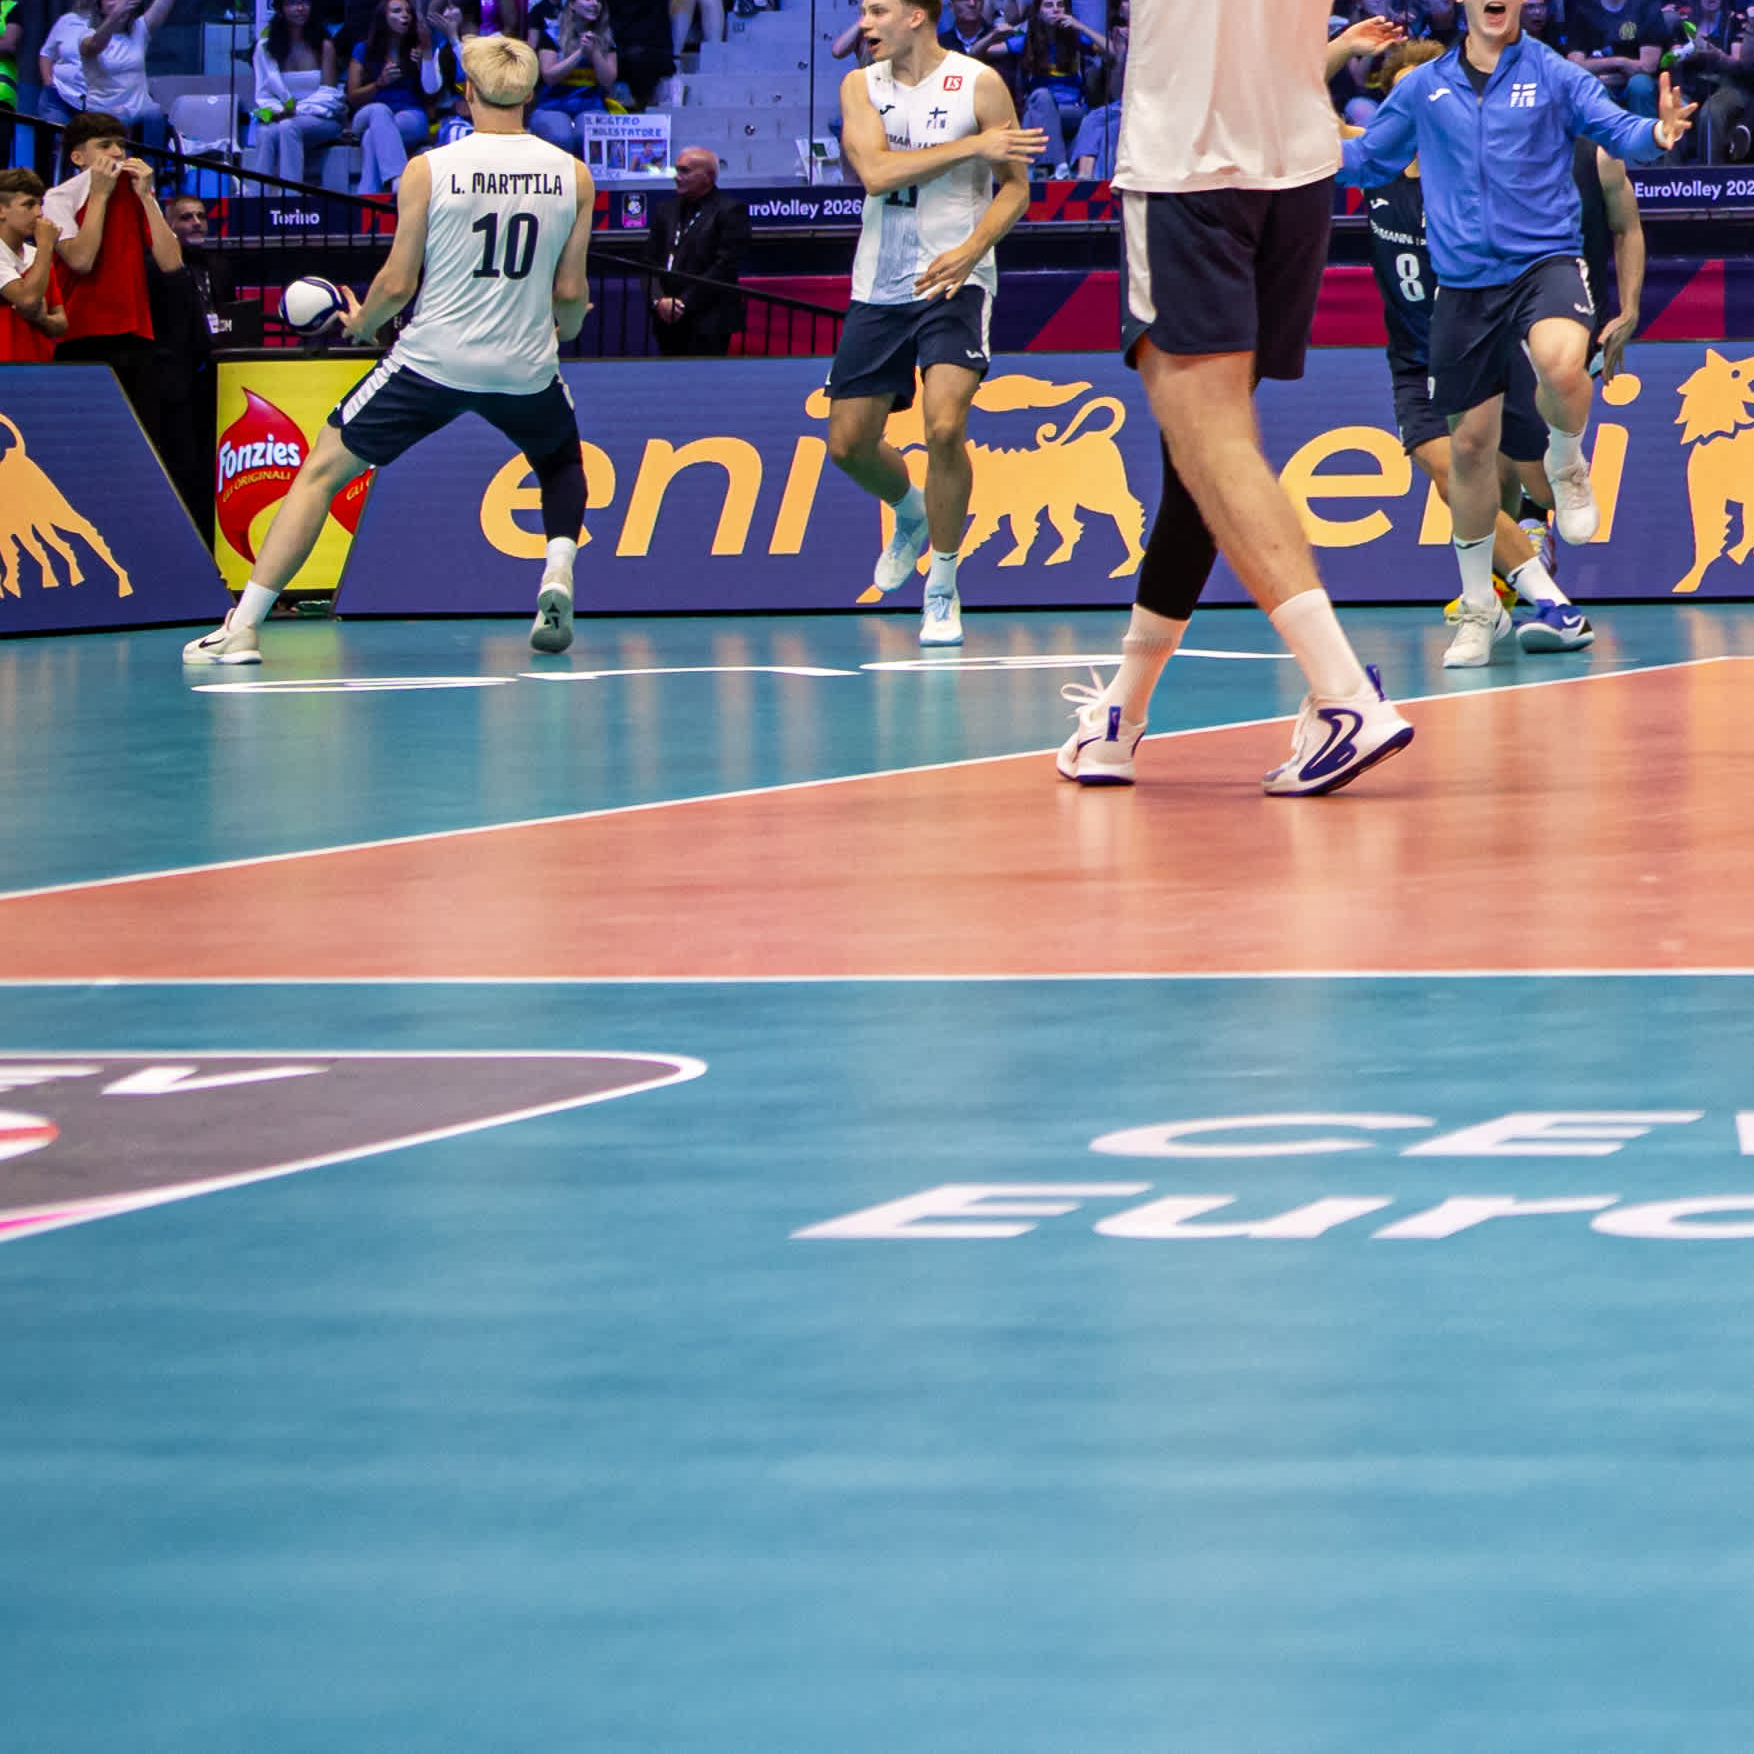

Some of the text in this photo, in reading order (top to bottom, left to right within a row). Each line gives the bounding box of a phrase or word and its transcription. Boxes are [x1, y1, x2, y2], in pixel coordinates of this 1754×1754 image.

[451, 172, 563, 196] L. MARTTILA
[1634, 181, 1723, 201] EuroVolley
[269, 209, 321, 226] Torino
[748, 199, 863, 220] roVolley 2026
[472, 212, 540, 281] 10
[1395, 252, 1426, 302] 8
[218, 433, 301, 494] Fonzies
[481, 386, 833, 560] eni
[1276, 372, 1641, 547] ei
[234, 471, 292, 492] ORIGINALI
